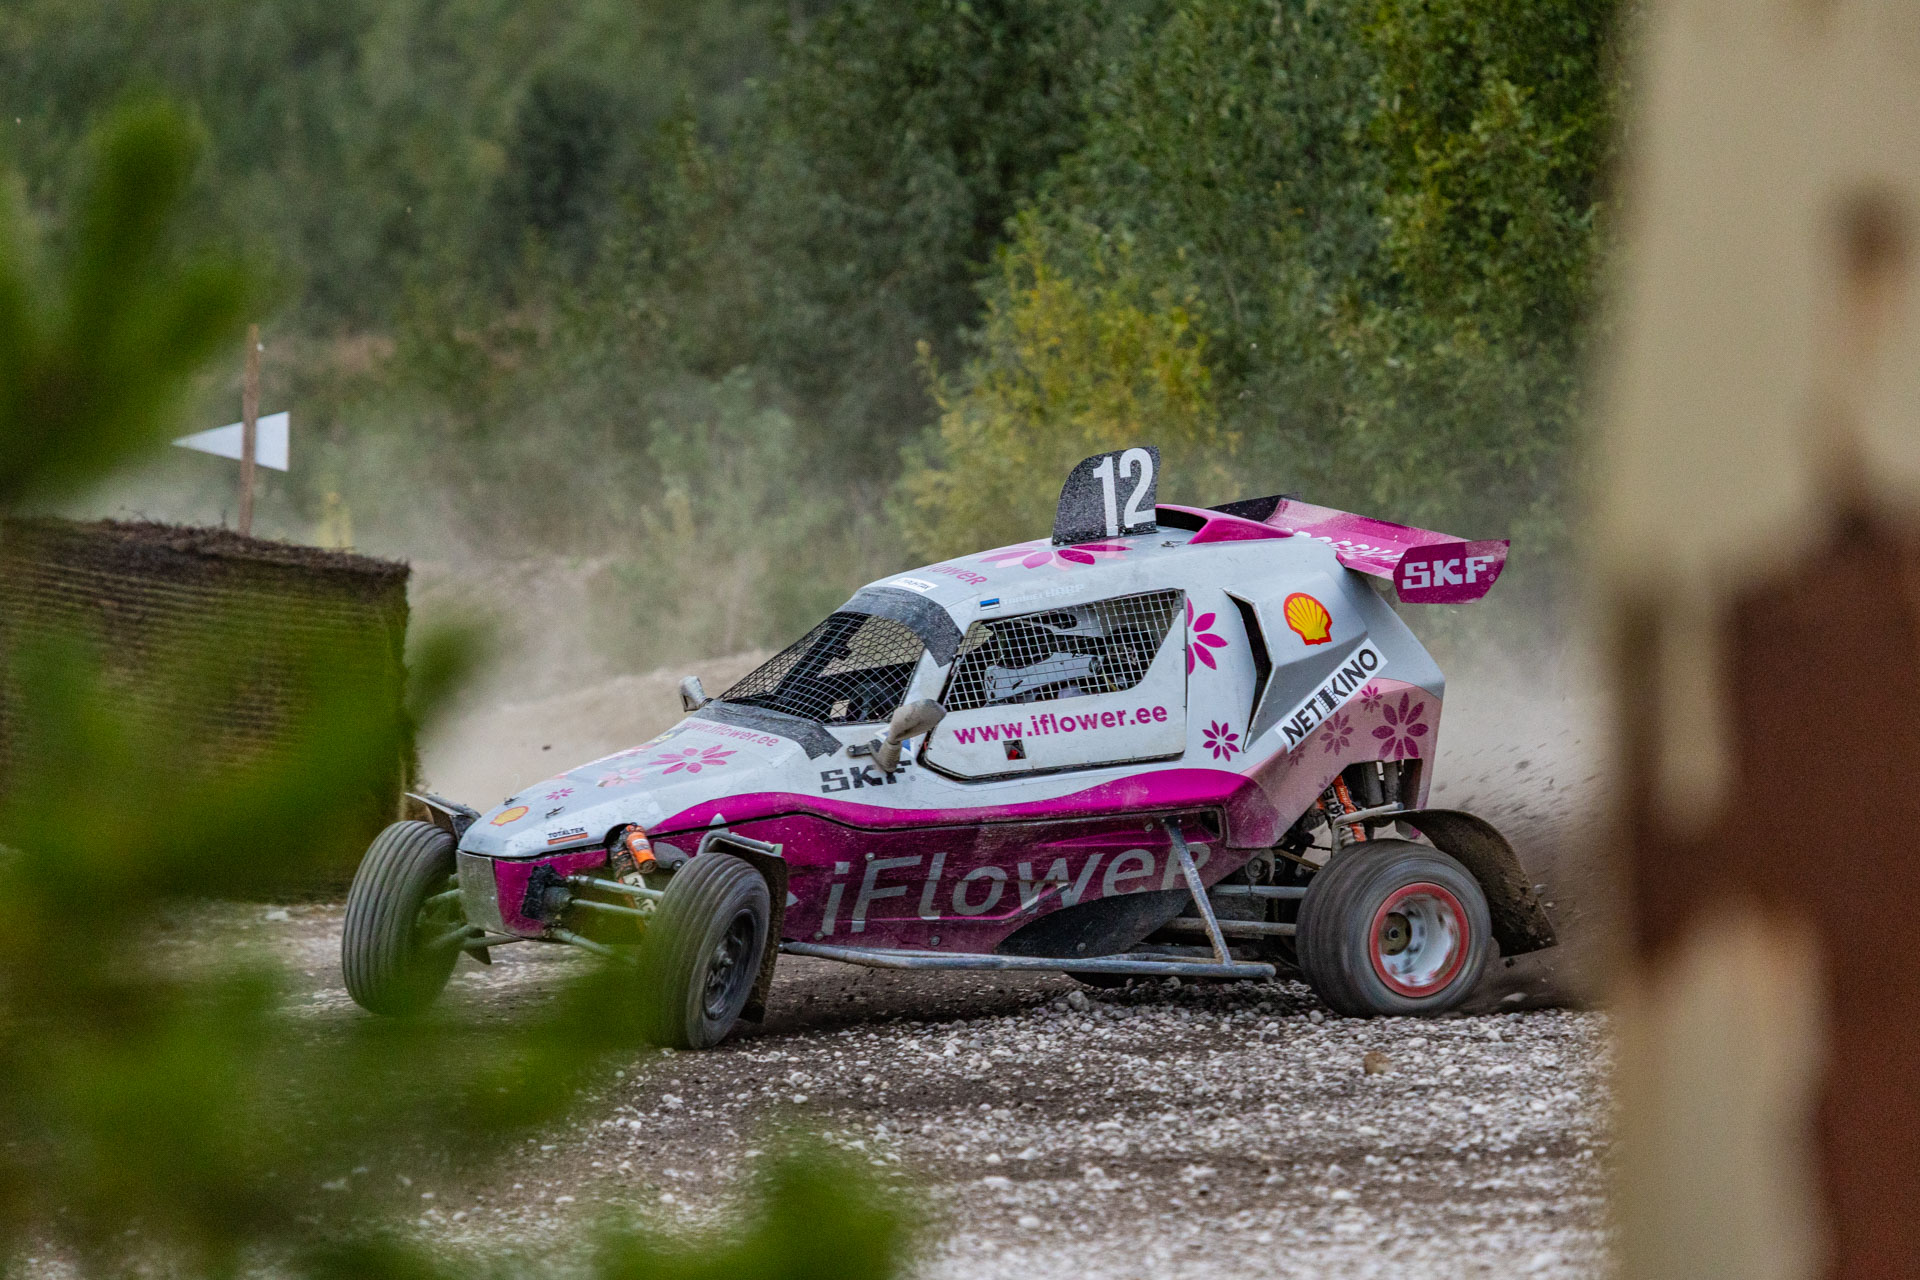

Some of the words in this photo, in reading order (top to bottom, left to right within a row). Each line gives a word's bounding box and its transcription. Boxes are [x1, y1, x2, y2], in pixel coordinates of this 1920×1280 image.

[1092, 446, 1156, 537] 12
[1402, 555, 1495, 589] SKF
[953, 704, 1168, 745] www.iflower.ee
[820, 759, 912, 793] SKF
